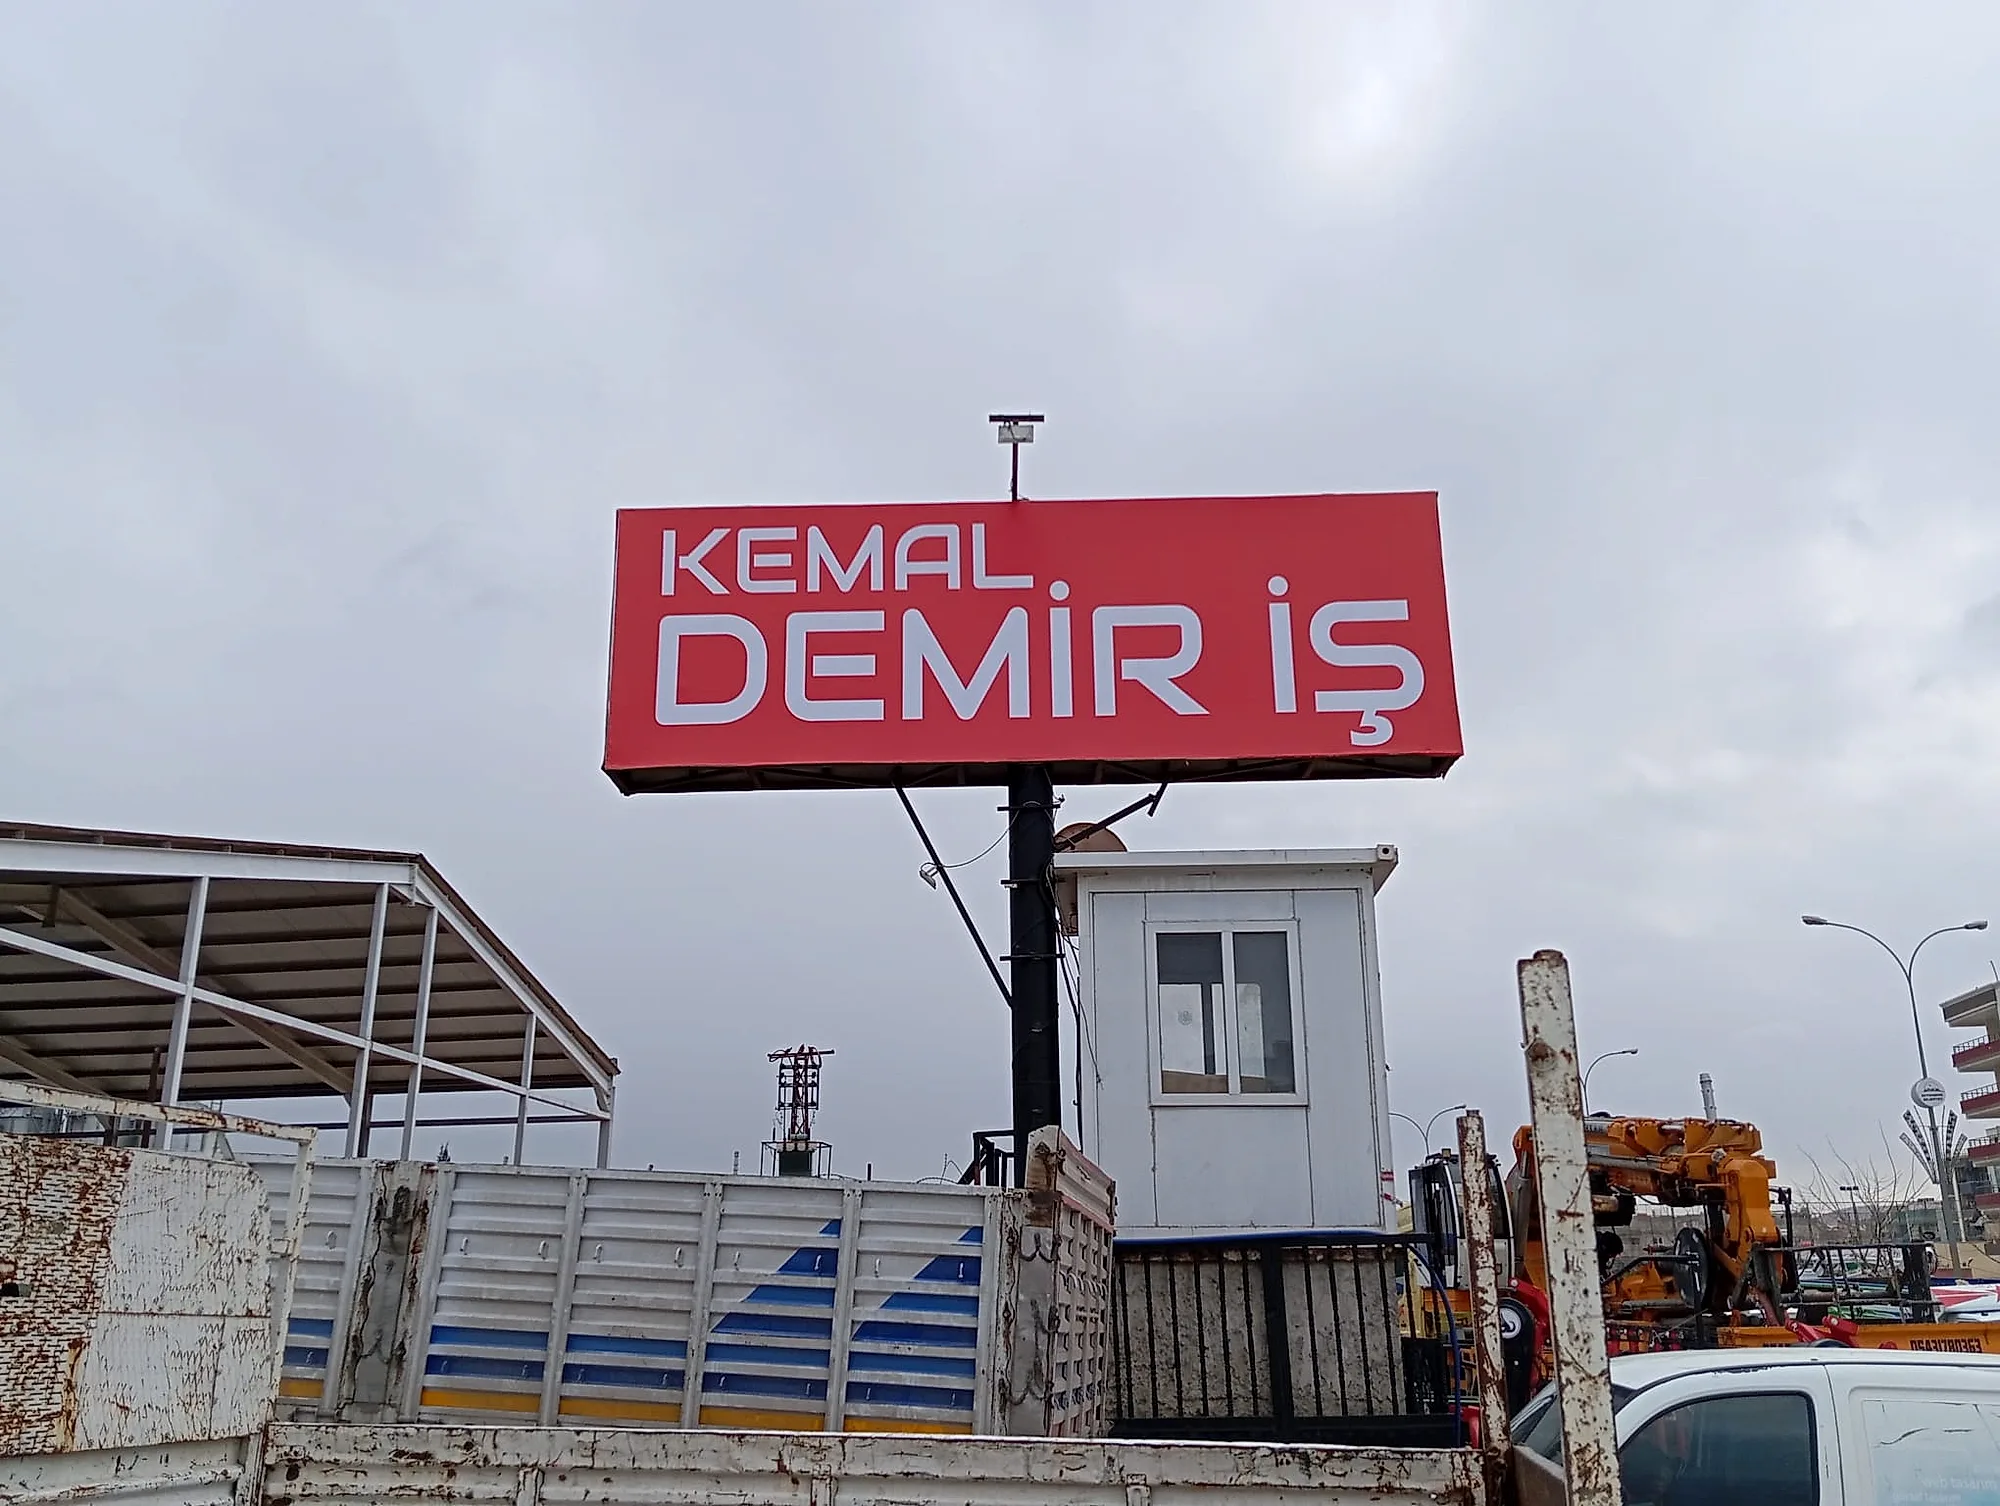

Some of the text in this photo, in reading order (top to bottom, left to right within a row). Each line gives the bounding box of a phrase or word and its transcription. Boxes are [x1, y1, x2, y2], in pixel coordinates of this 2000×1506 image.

[661, 522, 1034, 597] KEMAL
[655, 575, 1425, 747] DEMİR İŞ
